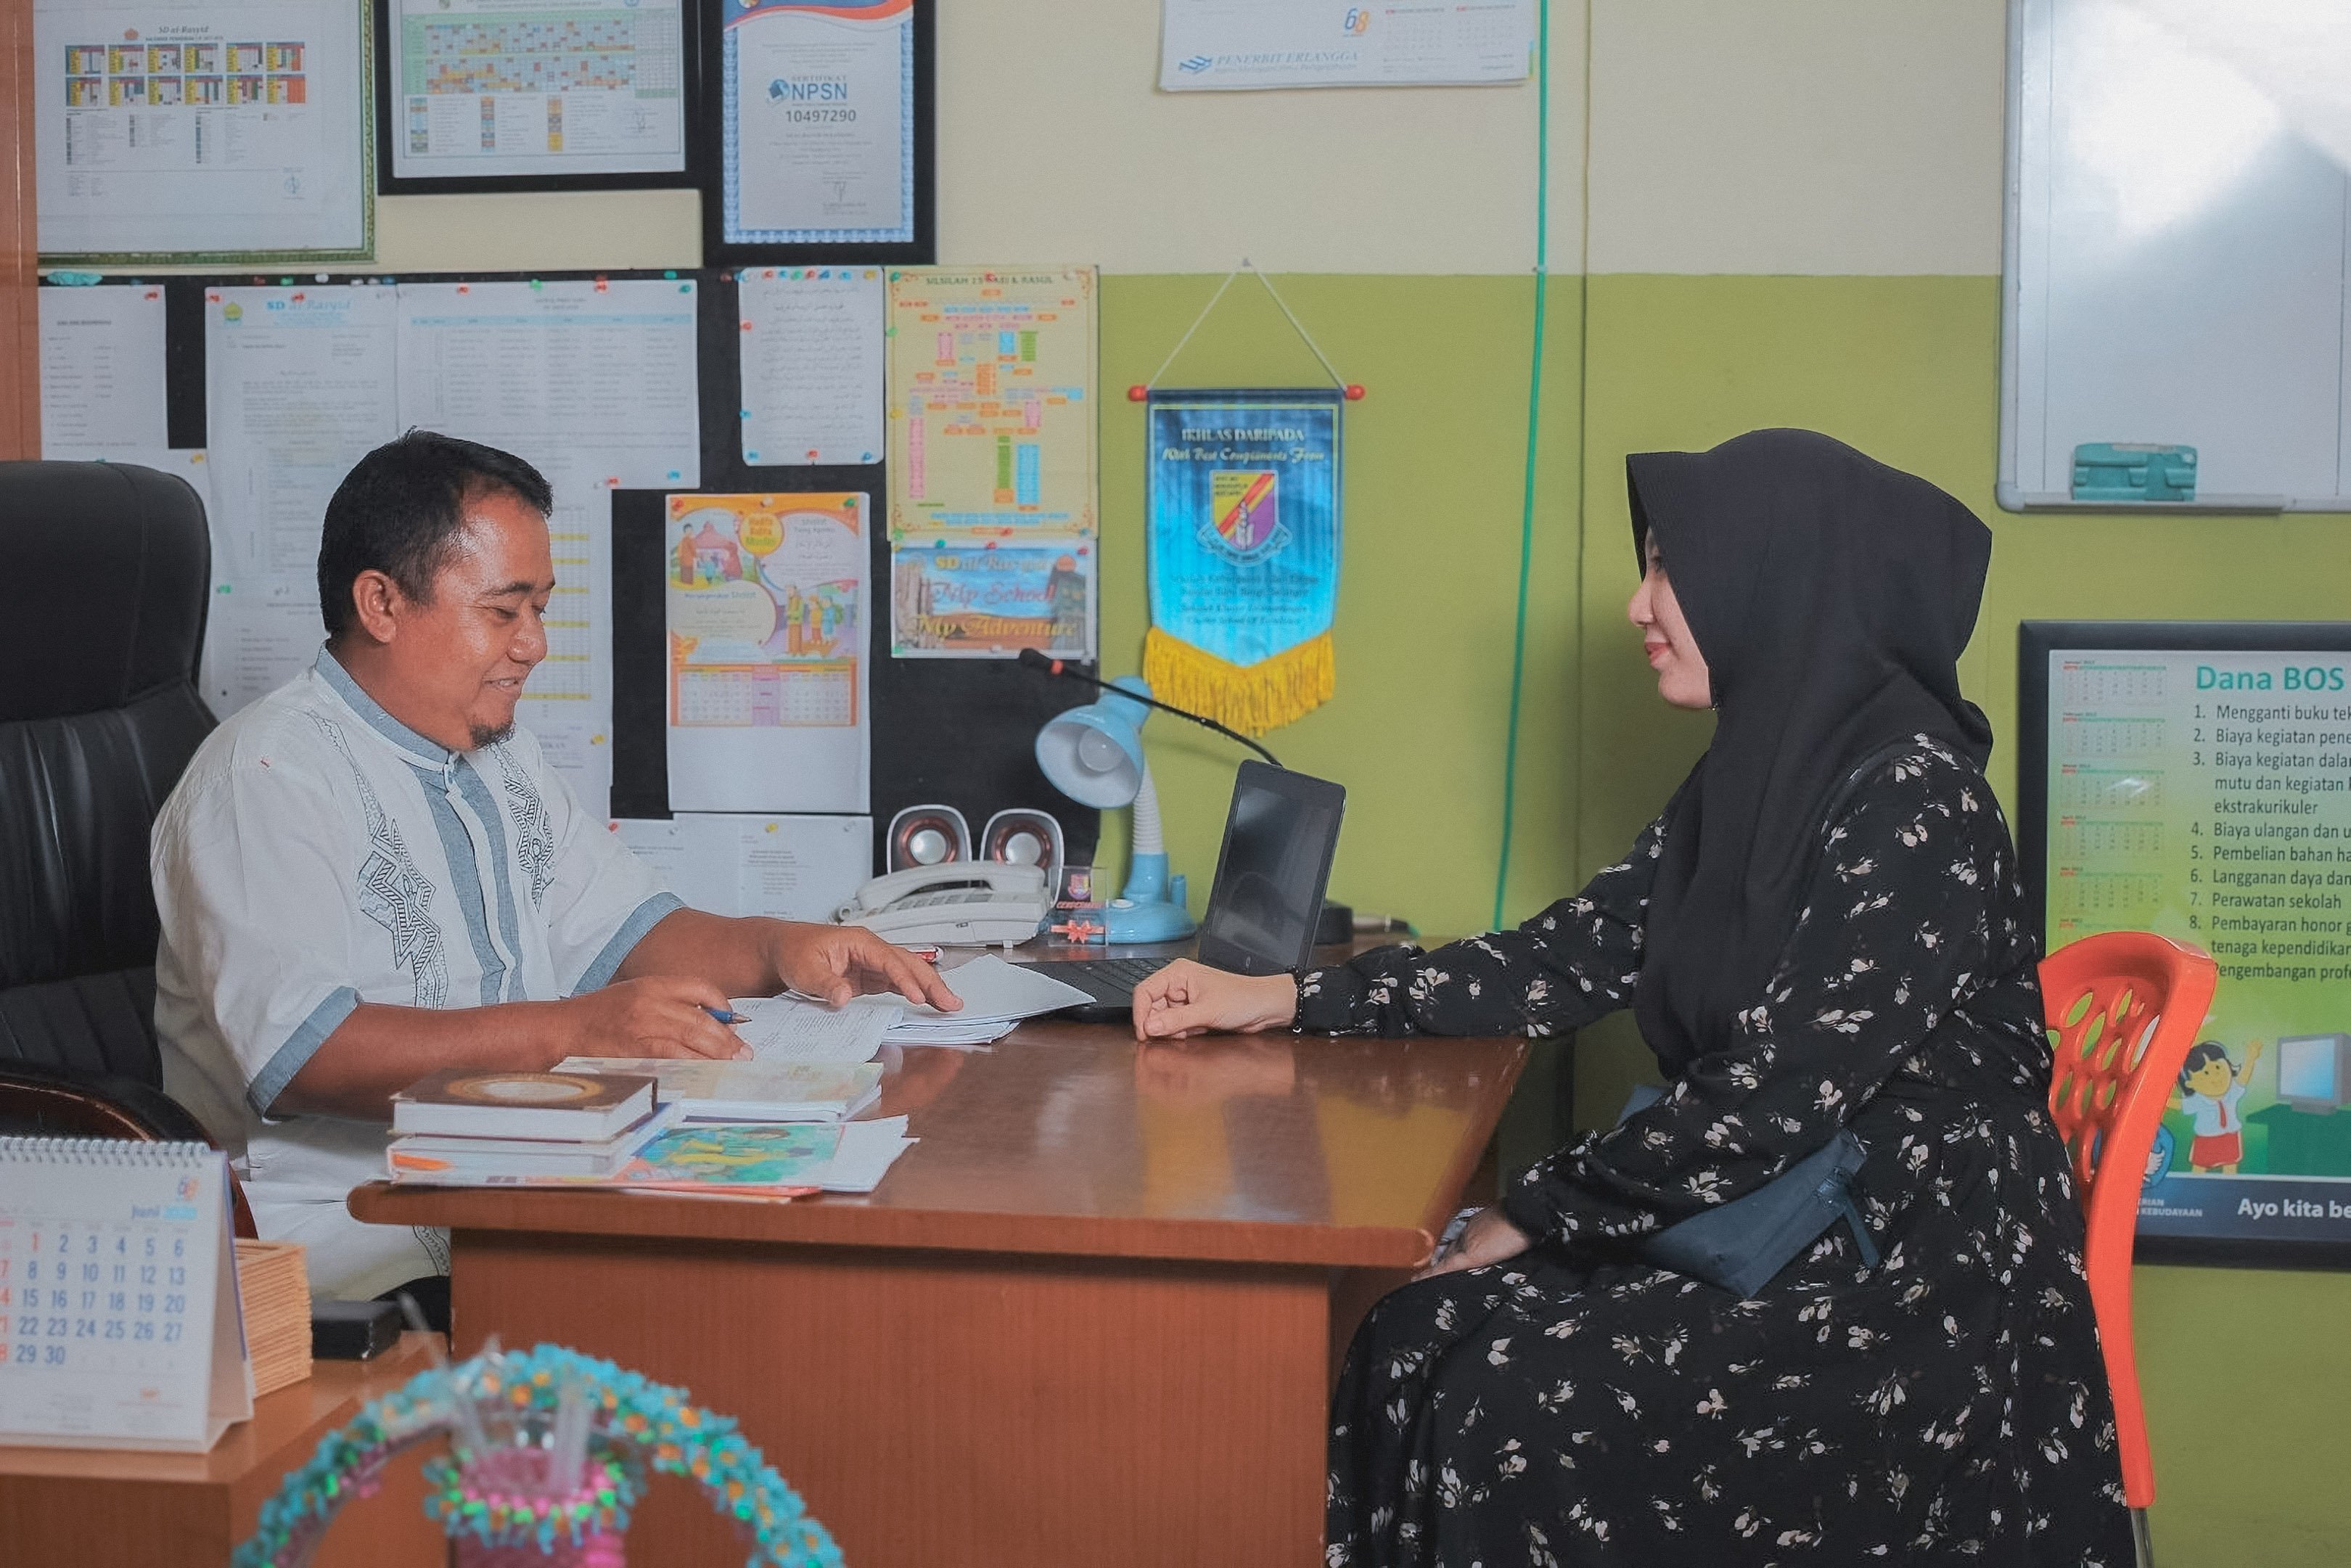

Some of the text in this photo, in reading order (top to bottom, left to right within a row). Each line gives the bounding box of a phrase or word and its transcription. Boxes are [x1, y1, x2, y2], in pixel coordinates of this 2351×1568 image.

[792, 83, 848, 101] NPSN
[786, 110, 856, 123] 10497290
[1182, 428, 1305, 442] IKHLAS DARIPADA
[2196, 666, 2344, 691] Dana BOS
[2194, 705, 2206, 718] 1.
[2217, 705, 2290, 723] Mengganti
[2295, 705, 2329, 720] buku
[2194, 728, 2205, 742] 2.
[2217, 728, 2252, 746] Biaya
[2257, 728, 2315, 747] kegiatan
[2193, 752, 2351, 770] 3. Biaya kegiatan dala
[2215, 775, 2343, 794] mutu dan kegiatan
[2215, 799, 2318, 814] ekstrakurikuler
[2191, 822, 2203, 835] 4.
[2215, 822, 2250, 840] Biaya
[2254, 822, 2309, 841] ulangan
[2313, 824, 2338, 838] dan
[2191, 845, 2202, 859] 5.
[2214, 845, 2285, 861] Pembelian
[2290, 846, 2332, 861] bahan
[2190, 869, 2202, 883] 6.
[2213, 869, 2286, 887] Langganan
[2290, 869, 2322, 888] daya
[2190, 892, 2342, 908] 7. Perawatan sekolah
[2189, 915, 2201, 929] 8.
[2212, 916, 2296, 933] Pembayaran
[2301, 916, 2342, 932] honor
[2211, 940, 2257, 957] tenaga
[2216, 963, 2315, 982] engembangan
[2141, 1207, 2203, 1217] KEBUDAYAAN
[2237, 1198, 2351, 1220] Ayo kita be
[32, 1234, 184, 1257] 1 2 3 4 5 6
[28, 1260, 38, 1279] 8
[57, 1262, 67, 1280] 9
[82, 1263, 99, 1281] 10
[113, 1265, 125, 1282] 11
[141, 1265, 155, 1284] 12
[169, 1267, 184, 1285] 13
[0, 1286, 184, 1313] 4 15 16 17 18 19 20
[18, 1315, 38, 1335] 22
[47, 1317, 67, 1336] 23
[75, 1318, 96, 1337] 24
[104, 1320, 124, 1339] 25
[134, 1321, 155, 1340] 26
[164, 1323, 182, 1342] 27
[16, 1344, 36, 1363] 29
[44, 1345, 66, 1365] 30
